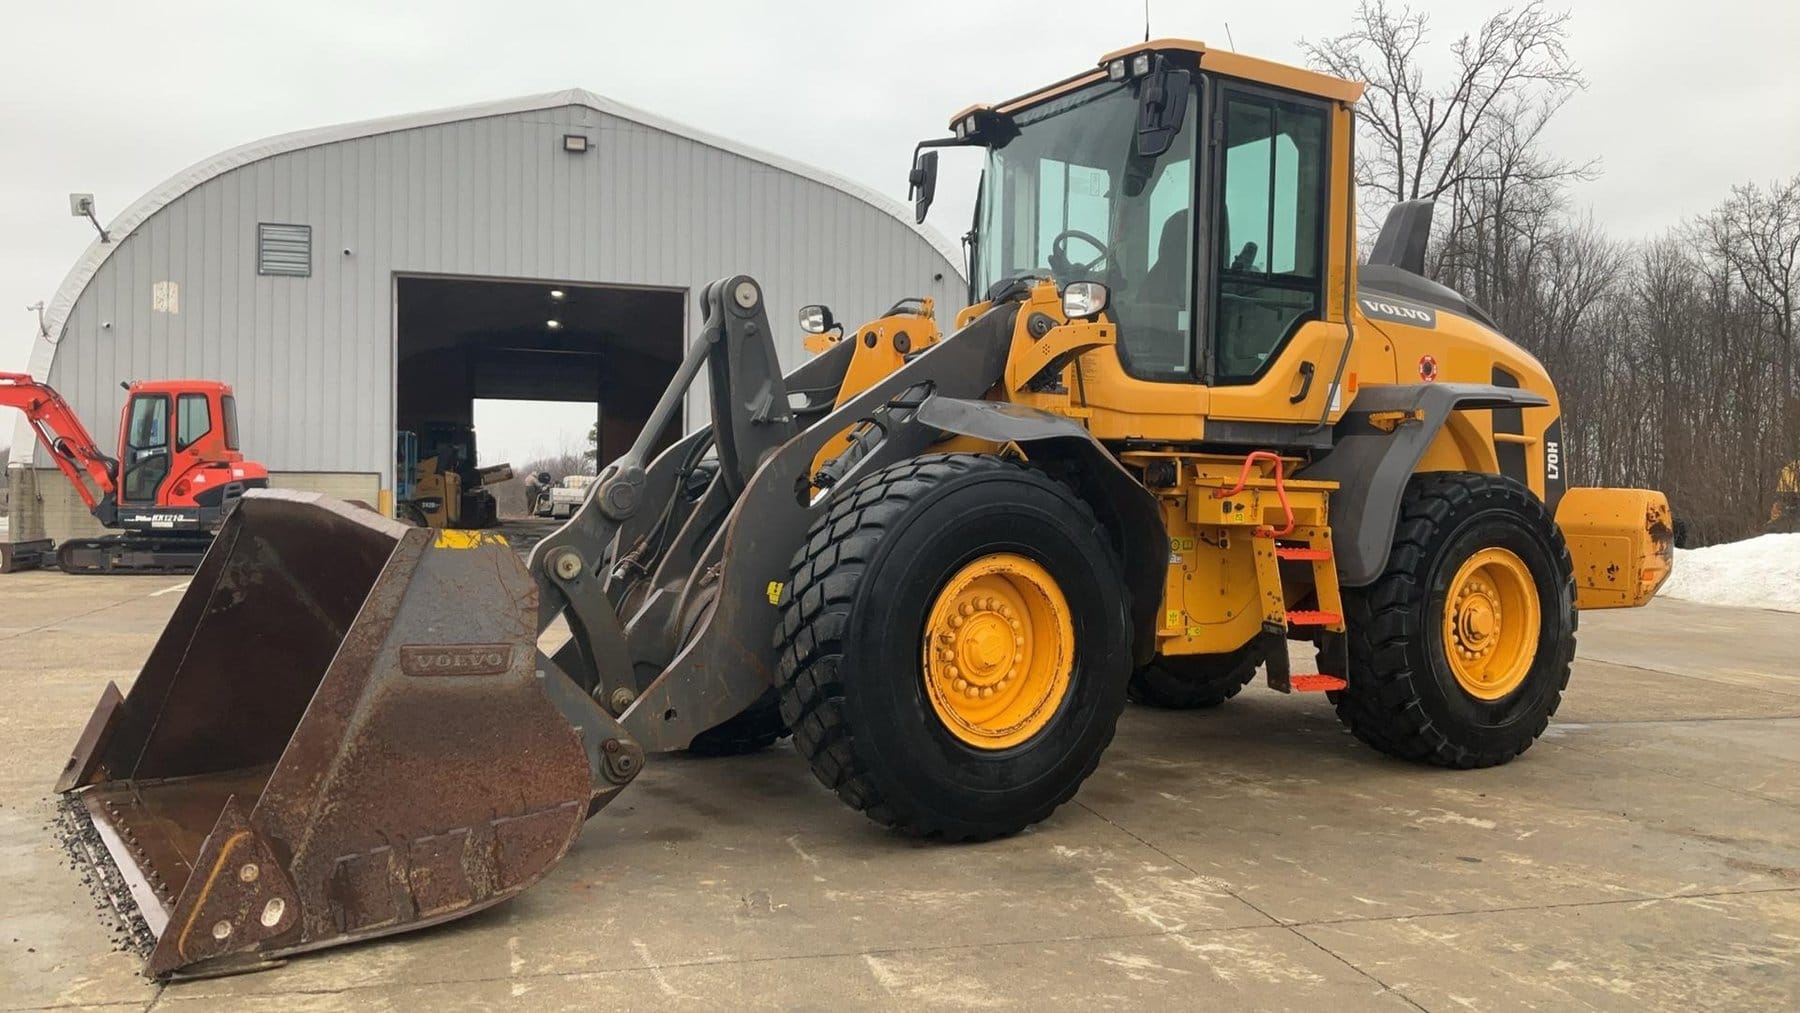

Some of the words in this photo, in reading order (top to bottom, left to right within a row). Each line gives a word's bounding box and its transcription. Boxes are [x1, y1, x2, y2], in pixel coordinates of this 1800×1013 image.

[1361, 299, 1431, 322] VOLVO
[1547, 441, 1559, 480] L70H
[415, 654, 503, 668] VOLVO
